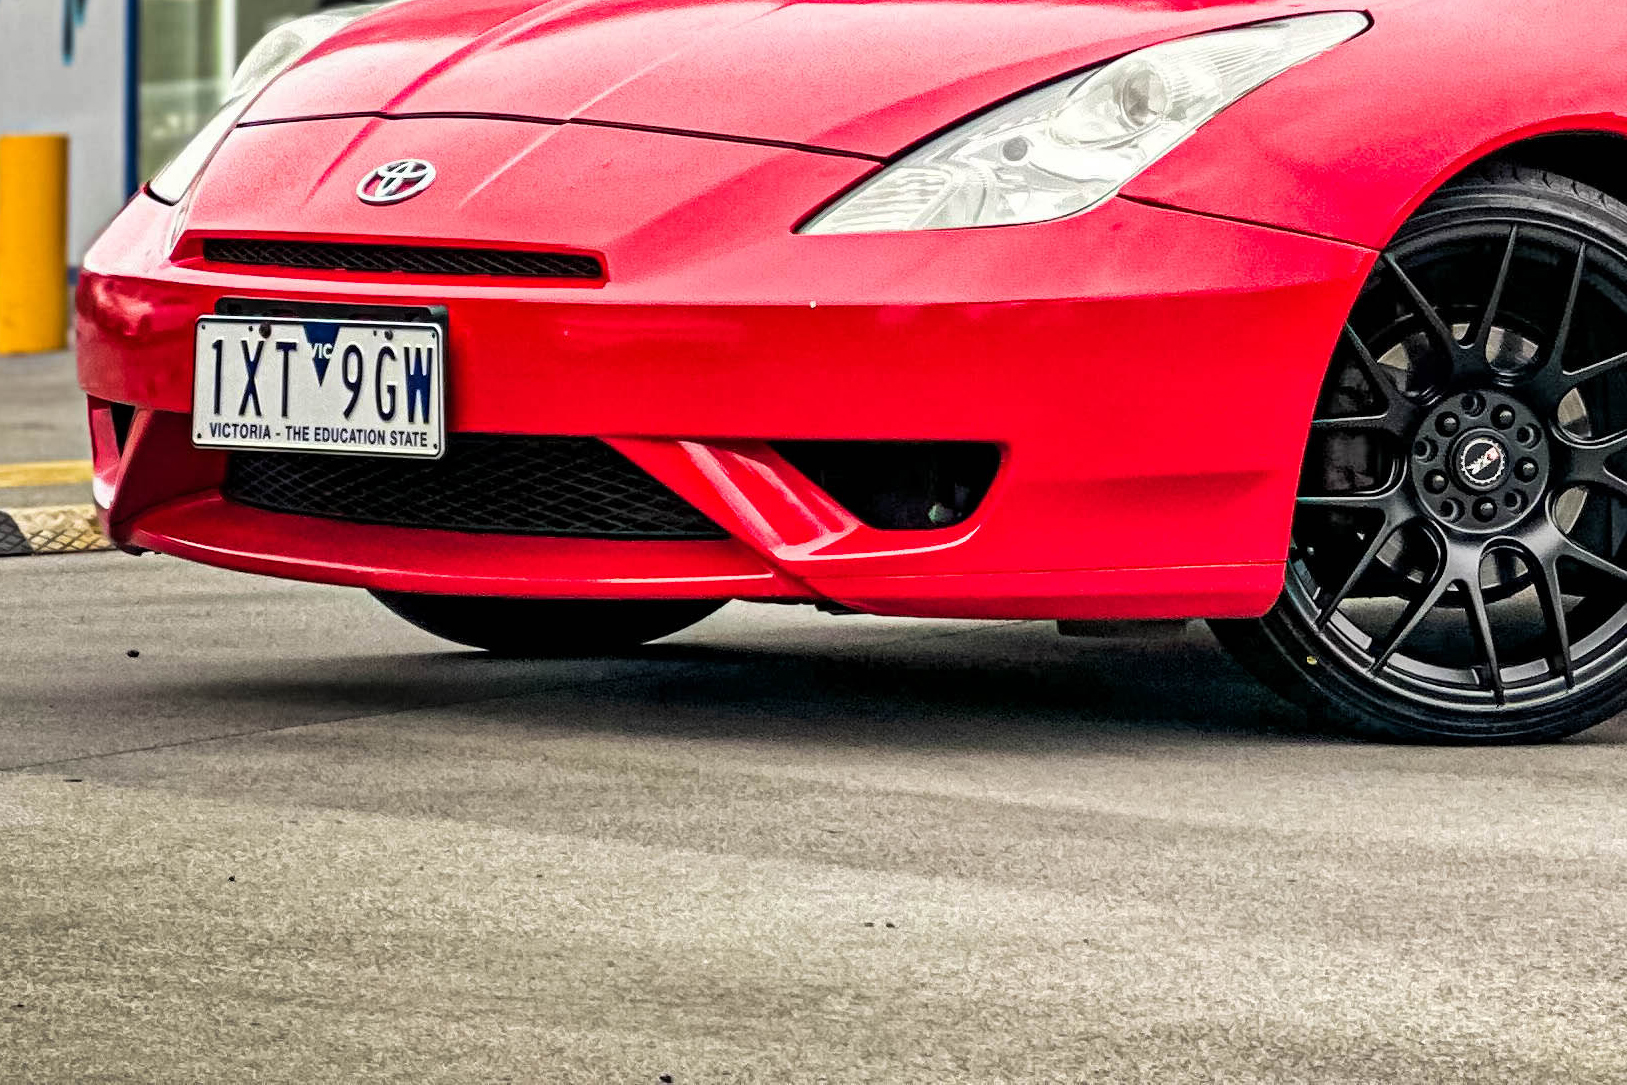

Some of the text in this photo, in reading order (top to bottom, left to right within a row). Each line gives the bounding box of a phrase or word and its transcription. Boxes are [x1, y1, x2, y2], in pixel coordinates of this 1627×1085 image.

[308, 342, 334, 360] VIC
[212, 339, 434, 425] 1XT 9GW
[209, 422, 271, 440] VICTORIA
[285, 426, 310, 442] THE
[314, 427, 386, 445] EDUCATION
[390, 430, 428, 447] STATE
